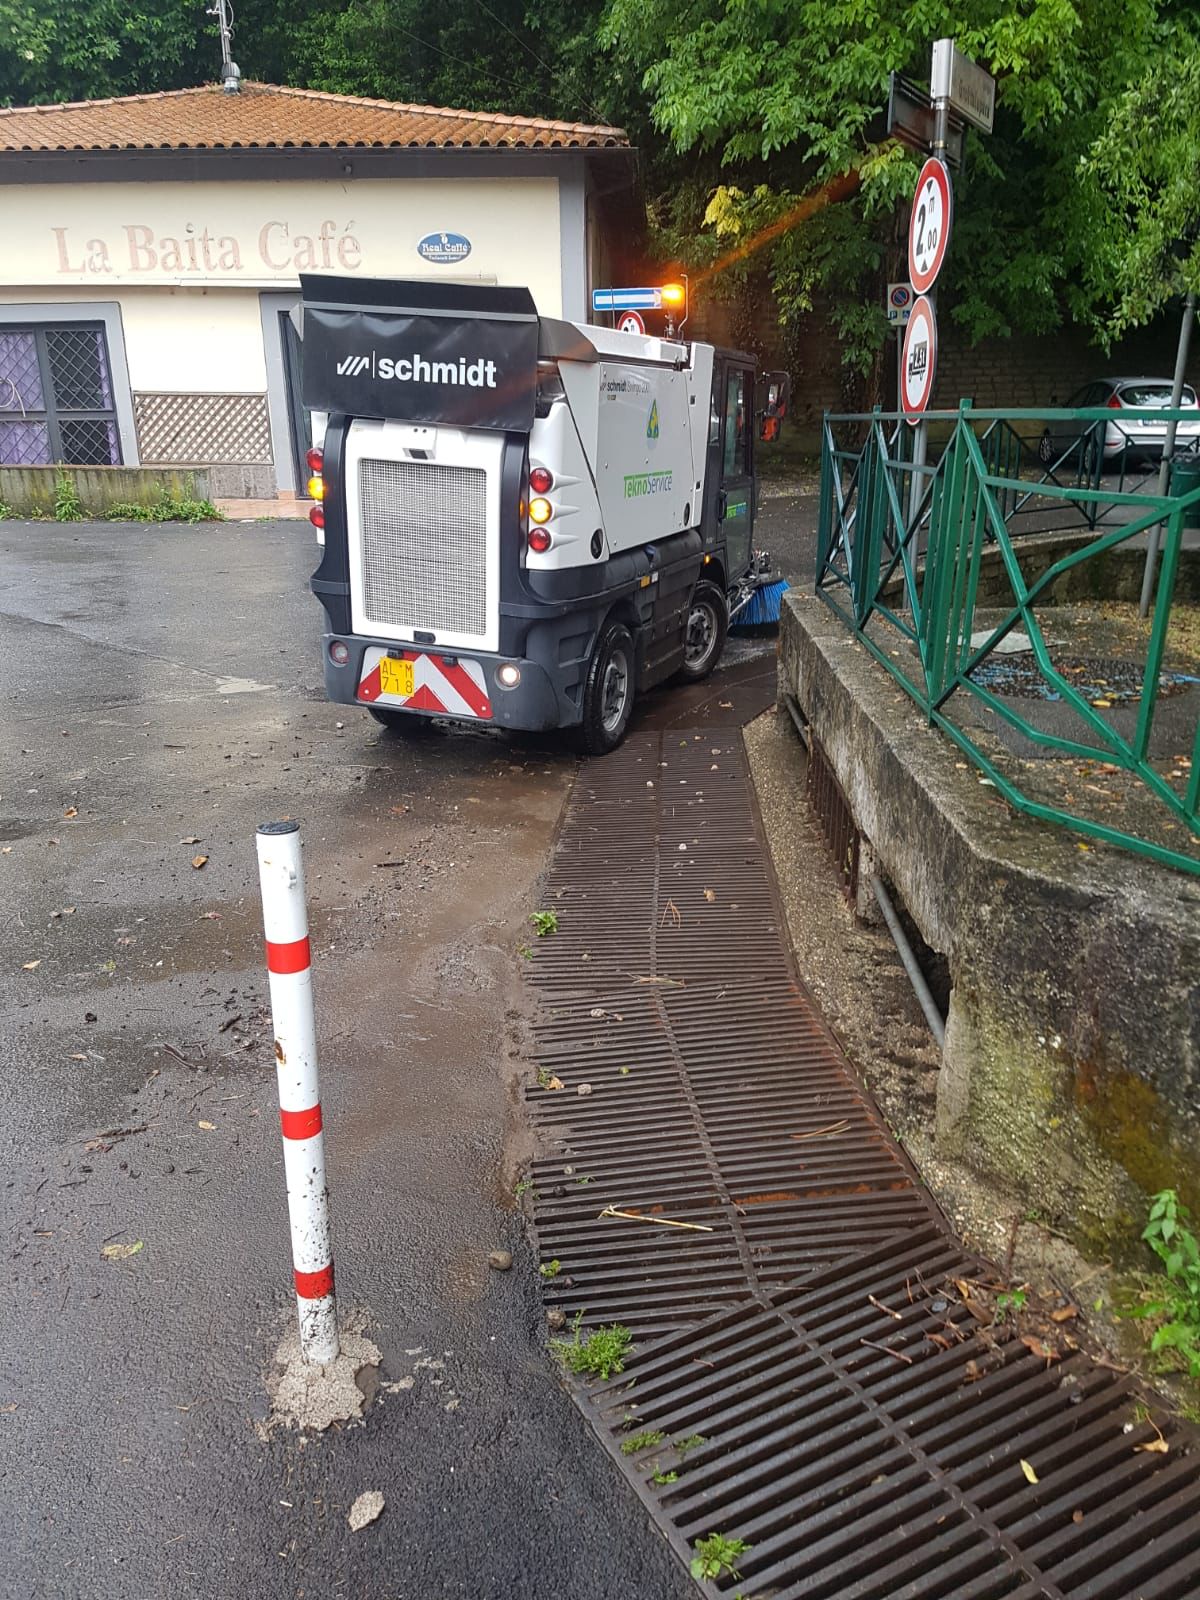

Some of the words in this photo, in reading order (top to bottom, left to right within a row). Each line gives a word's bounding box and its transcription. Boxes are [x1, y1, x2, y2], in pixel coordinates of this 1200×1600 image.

[51, 227, 112, 273] La
[122, 222, 244, 272] Baita
[258, 220, 361, 270] Café
[422, 243, 443, 252] Real
[378, 354, 497, 388] schmidt
[382, 660, 397, 676] AL
[405, 664, 413, 678] M
[382, 677, 413, 694] 718
